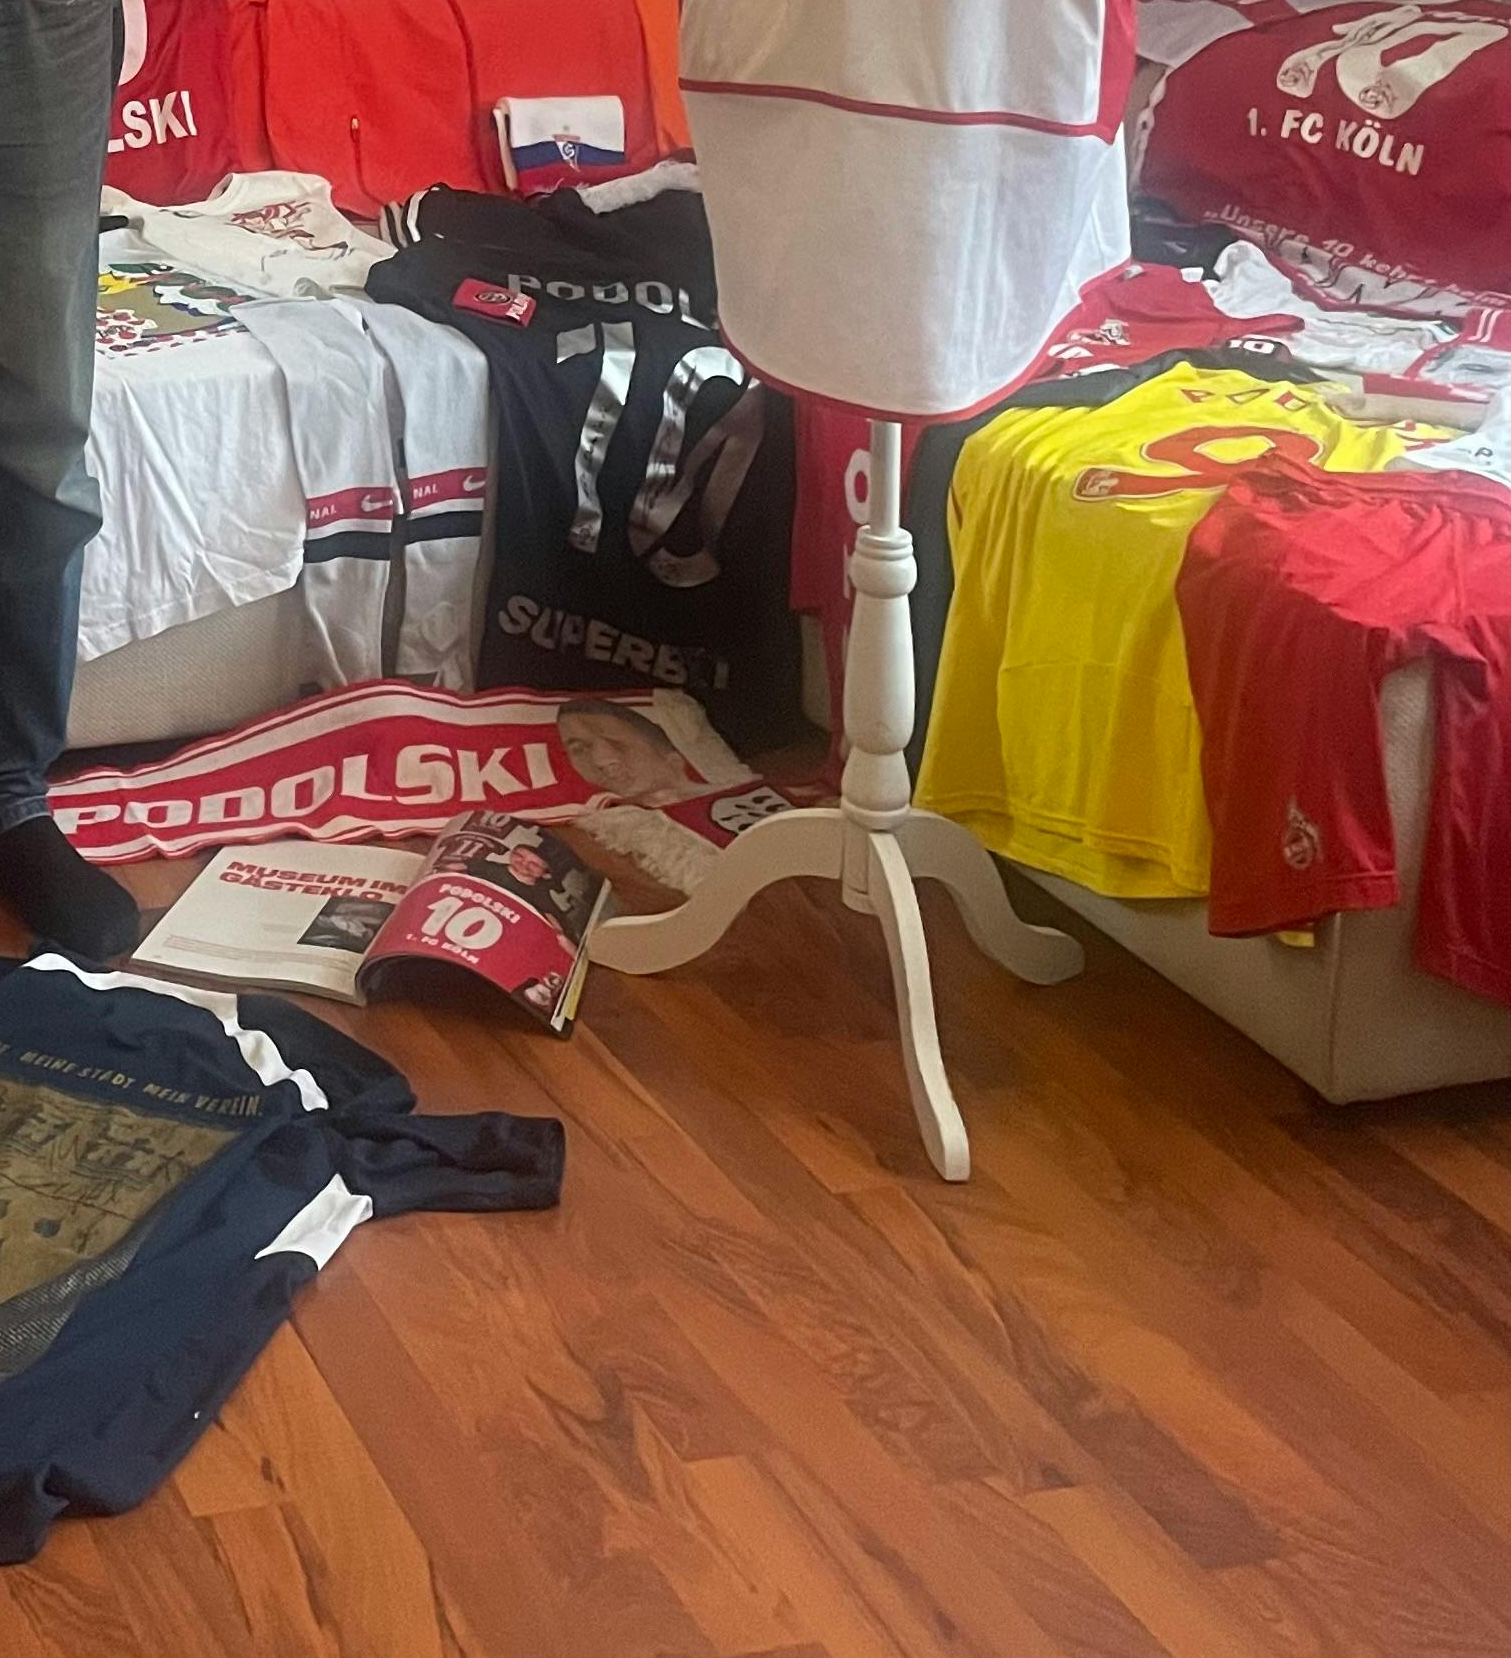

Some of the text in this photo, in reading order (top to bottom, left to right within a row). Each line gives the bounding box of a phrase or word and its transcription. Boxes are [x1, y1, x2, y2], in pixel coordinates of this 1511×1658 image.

[1246, 107, 1424, 176] 1. FC KÖLN
[556, 321, 769, 589] 10
[53, 742, 558, 836] PODOLSKI
[226, 861, 410, 895] MUSEUM IM
[439, 883, 522, 925] PODOLSKI
[420, 896, 504, 951] 10
[142, 1082, 191, 1105] MEIN
